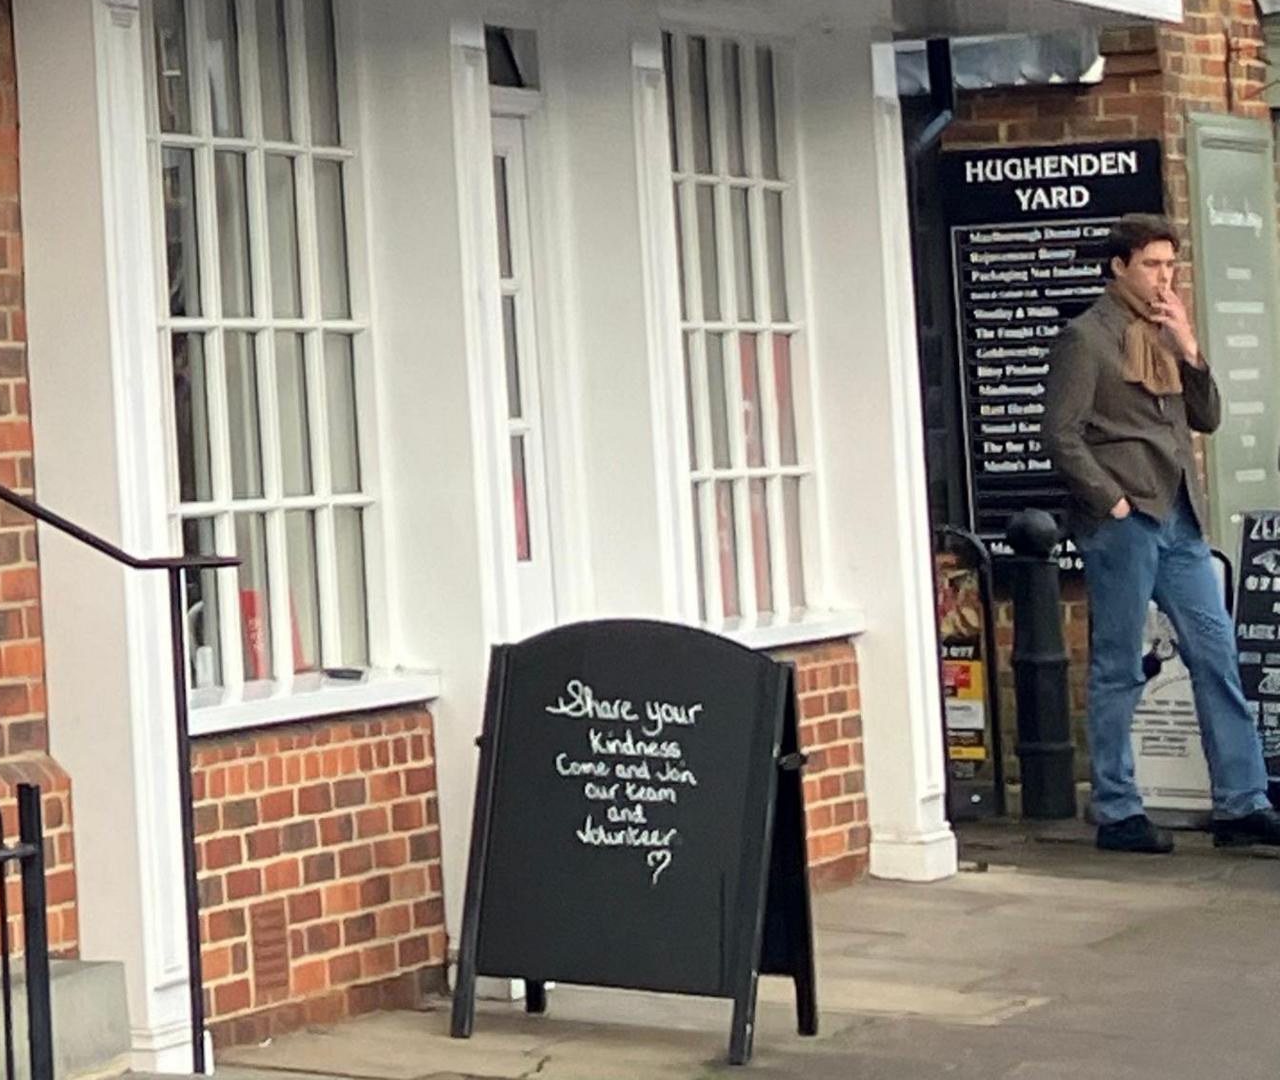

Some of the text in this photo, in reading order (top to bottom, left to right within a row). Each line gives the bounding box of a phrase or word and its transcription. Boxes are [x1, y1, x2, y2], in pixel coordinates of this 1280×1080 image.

[965, 150, 1139, 183] HUGHENDEN
[1014, 185, 1091, 212] YARD
[545, 680, 705, 737] Share your
[555, 753, 611, 779] Come
[614, 760, 650, 781] and
[584, 782, 678, 804] our team
[606, 804, 648, 824] and
